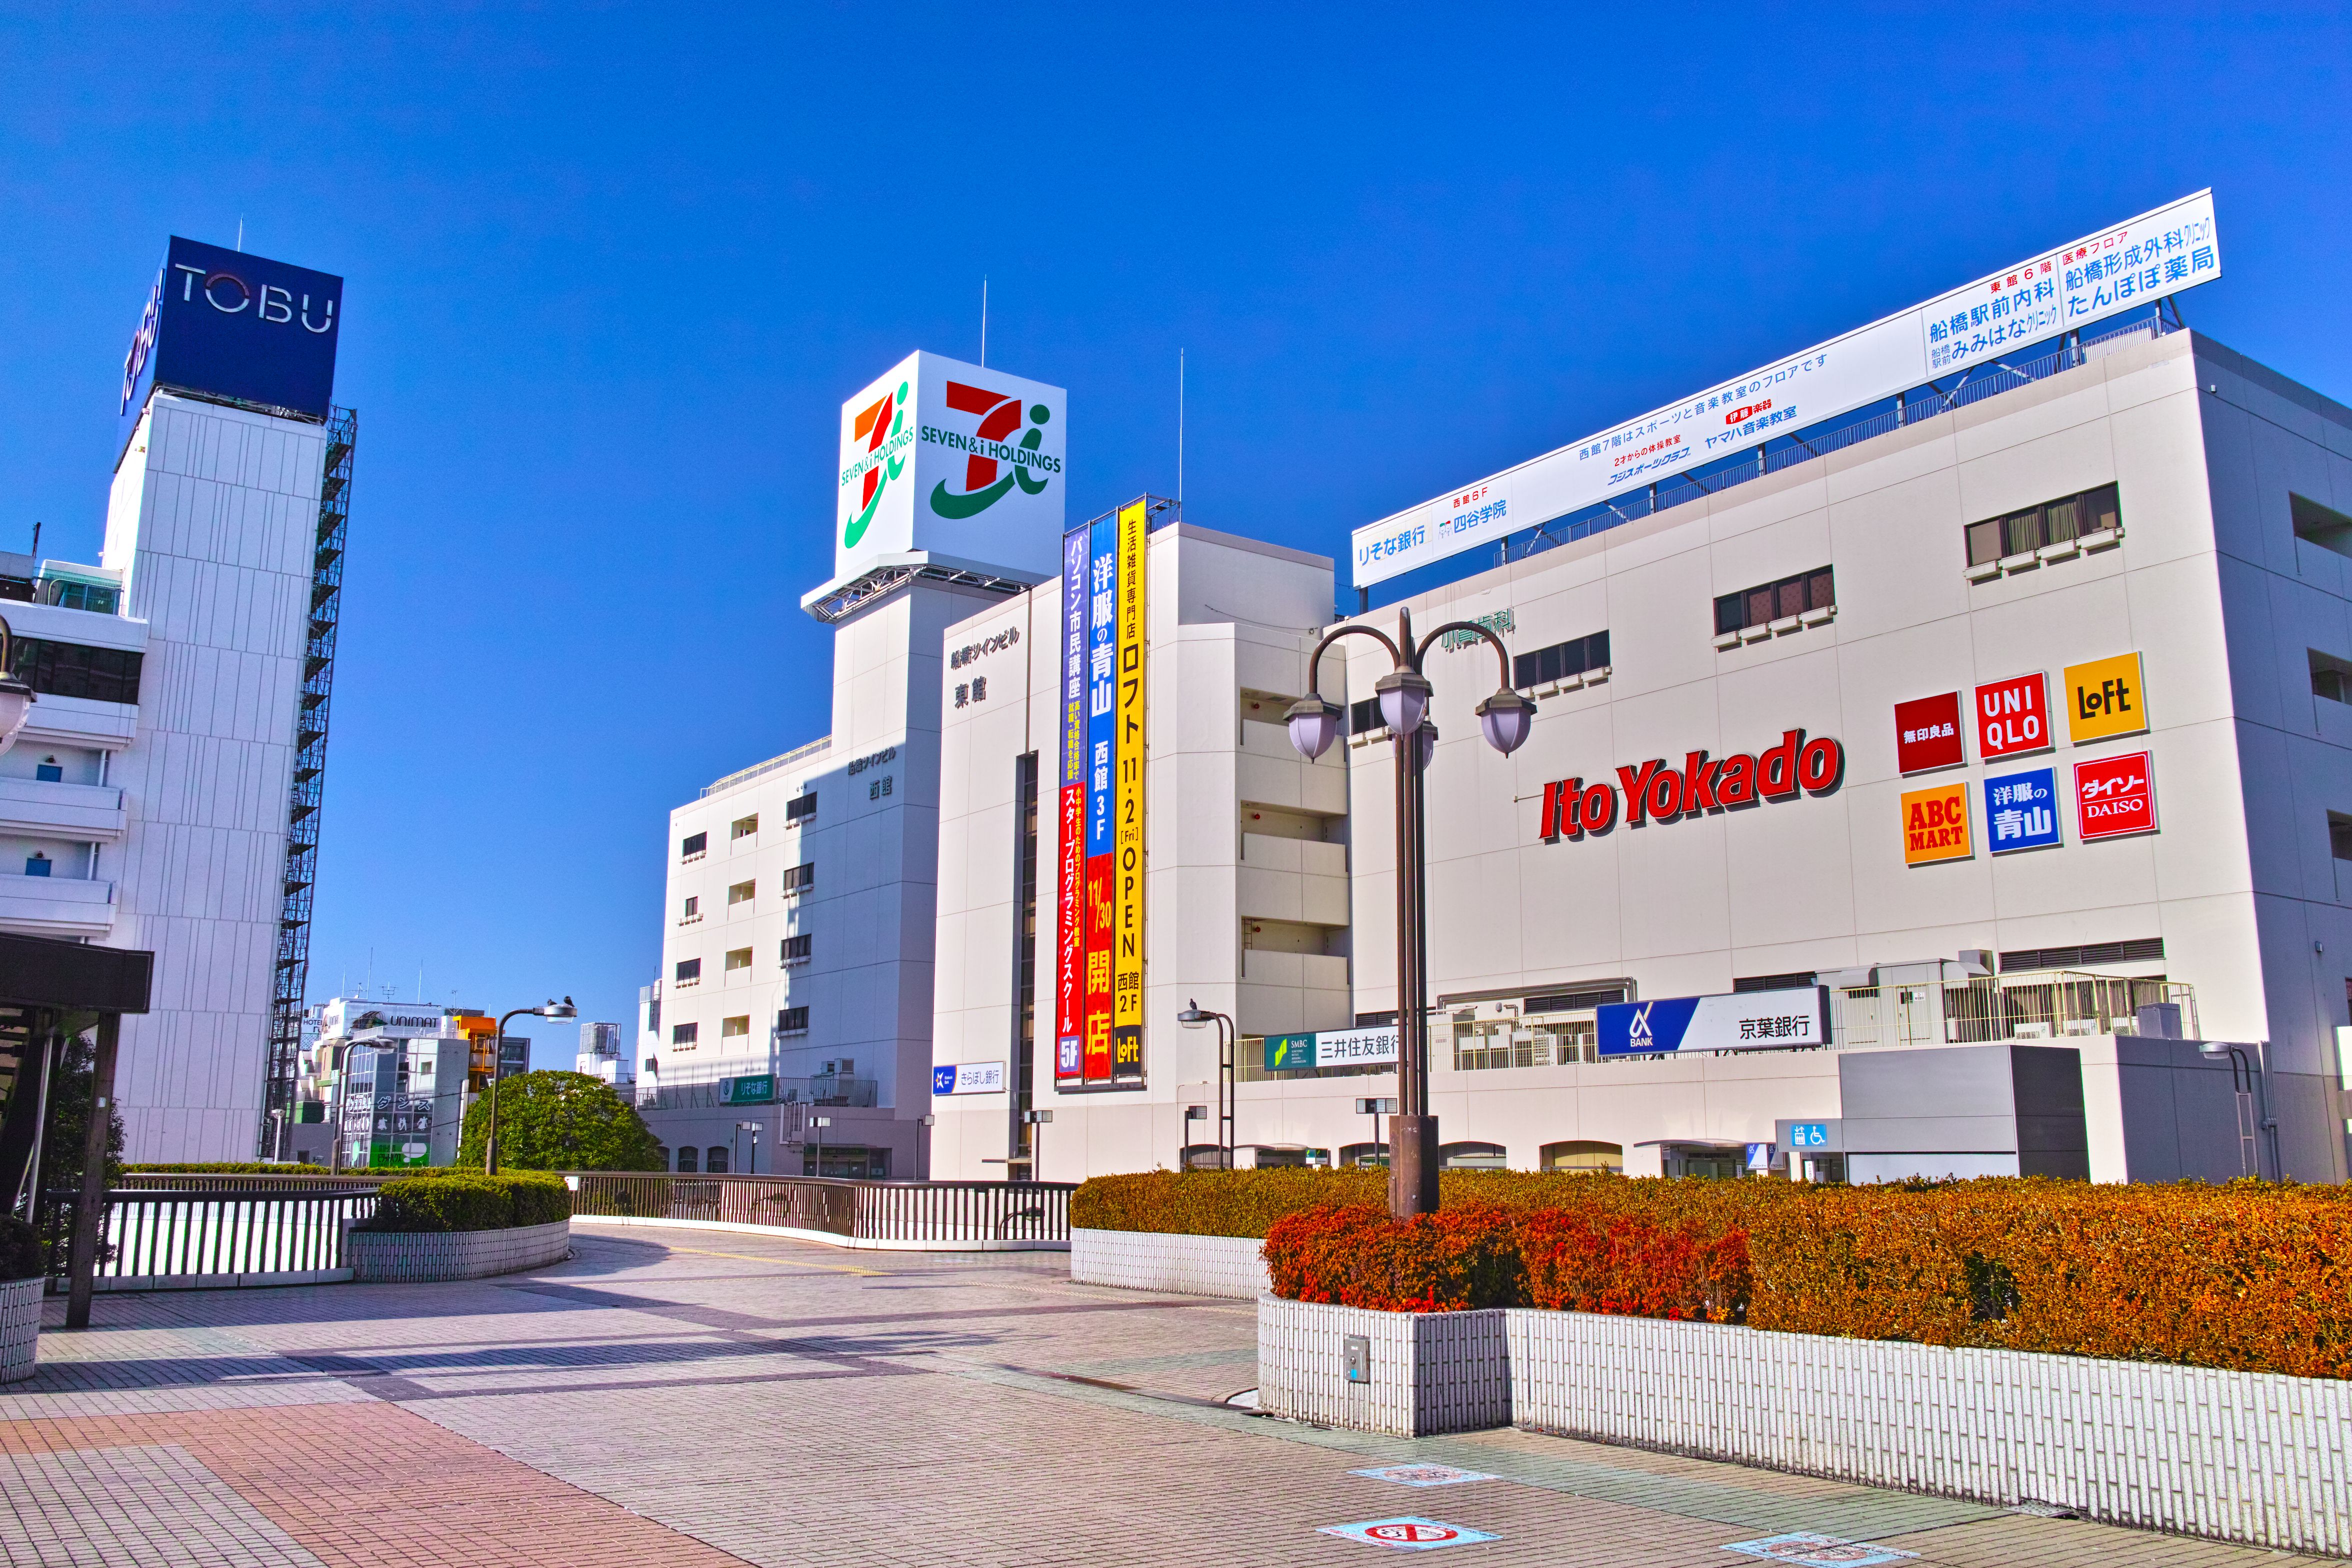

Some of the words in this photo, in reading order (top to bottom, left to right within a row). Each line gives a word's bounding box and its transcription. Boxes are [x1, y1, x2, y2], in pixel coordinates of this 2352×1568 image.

[2062, 230, 2128, 266] 医療フロア
[2066, 216, 2210, 292] 船橋形成外科クリニック
[175, 264, 332, 332] TOBU
[2068, 245, 2214, 317] たんぽぽ薬局
[1930, 278, 2054, 344] 船橋駅前内科
[1952, 304, 2056, 360] みみはなクリニック
[1705, 405, 1796, 449] ヤマハ音楽教室
[874, 426, 914, 468] HOLDINGS
[989, 443, 1061, 473] HOLDINGS
[1614, 434, 1682, 467] 2才からの体操教室
[1454, 499, 1506, 534] 四谷学院
[1359, 525, 1425, 566] りそな銀行
[1126, 518, 1137, 640] 生活雑貨専門店
[1068, 538, 1084, 700] パソコン市民講座
[1091, 552, 1113, 718] 洋服の青山
[950, 626, 1020, 670] 船橋ツインビル
[954, 676, 986, 709] 東館
[1123, 643, 1138, 744] ロフト
[1984, 685, 2032, 717] UNI
[1904, 722, 1954, 744] 無印良品
[1986, 715, 2040, 750] QLO
[848, 746, 896, 776] 船橋ツインビル
[870, 775, 892, 800] 西館
[1992, 782, 2048, 806] 洋服の
[2082, 775, 2145, 798] ダイソー
[1909, 796, 1962, 831] ABC
[1994, 806, 2052, 840] 青山
[2087, 798, 2144, 818] DAISO
[1910, 826, 1963, 851] MART
[1074, 787, 1082, 947] 小中学生のためのプログラミング教室
[1062, 789, 1075, 1032] スタープログラミングスクール
[1088, 876, 1111, 933] 11/30
[1123, 846, 1136, 958] OPEN
[1118, 971, 1139, 992] 西館
[1086, 950, 1110, 1055] 開店
[1120, 994, 1137, 1013] 2F
[1291, 1040, 1308, 1048] SMBC
[1630, 1037, 1653, 1047] BANK
[1739, 1015, 1810, 1040] 京葉銀行
[1061, 1040, 1078, 1068] 5F
[741, 1081, 768, 1095] りそな銀行
[961, 1070, 999, 1085] きらぼし銀行
[378, 1096, 430, 1110] ダンス
